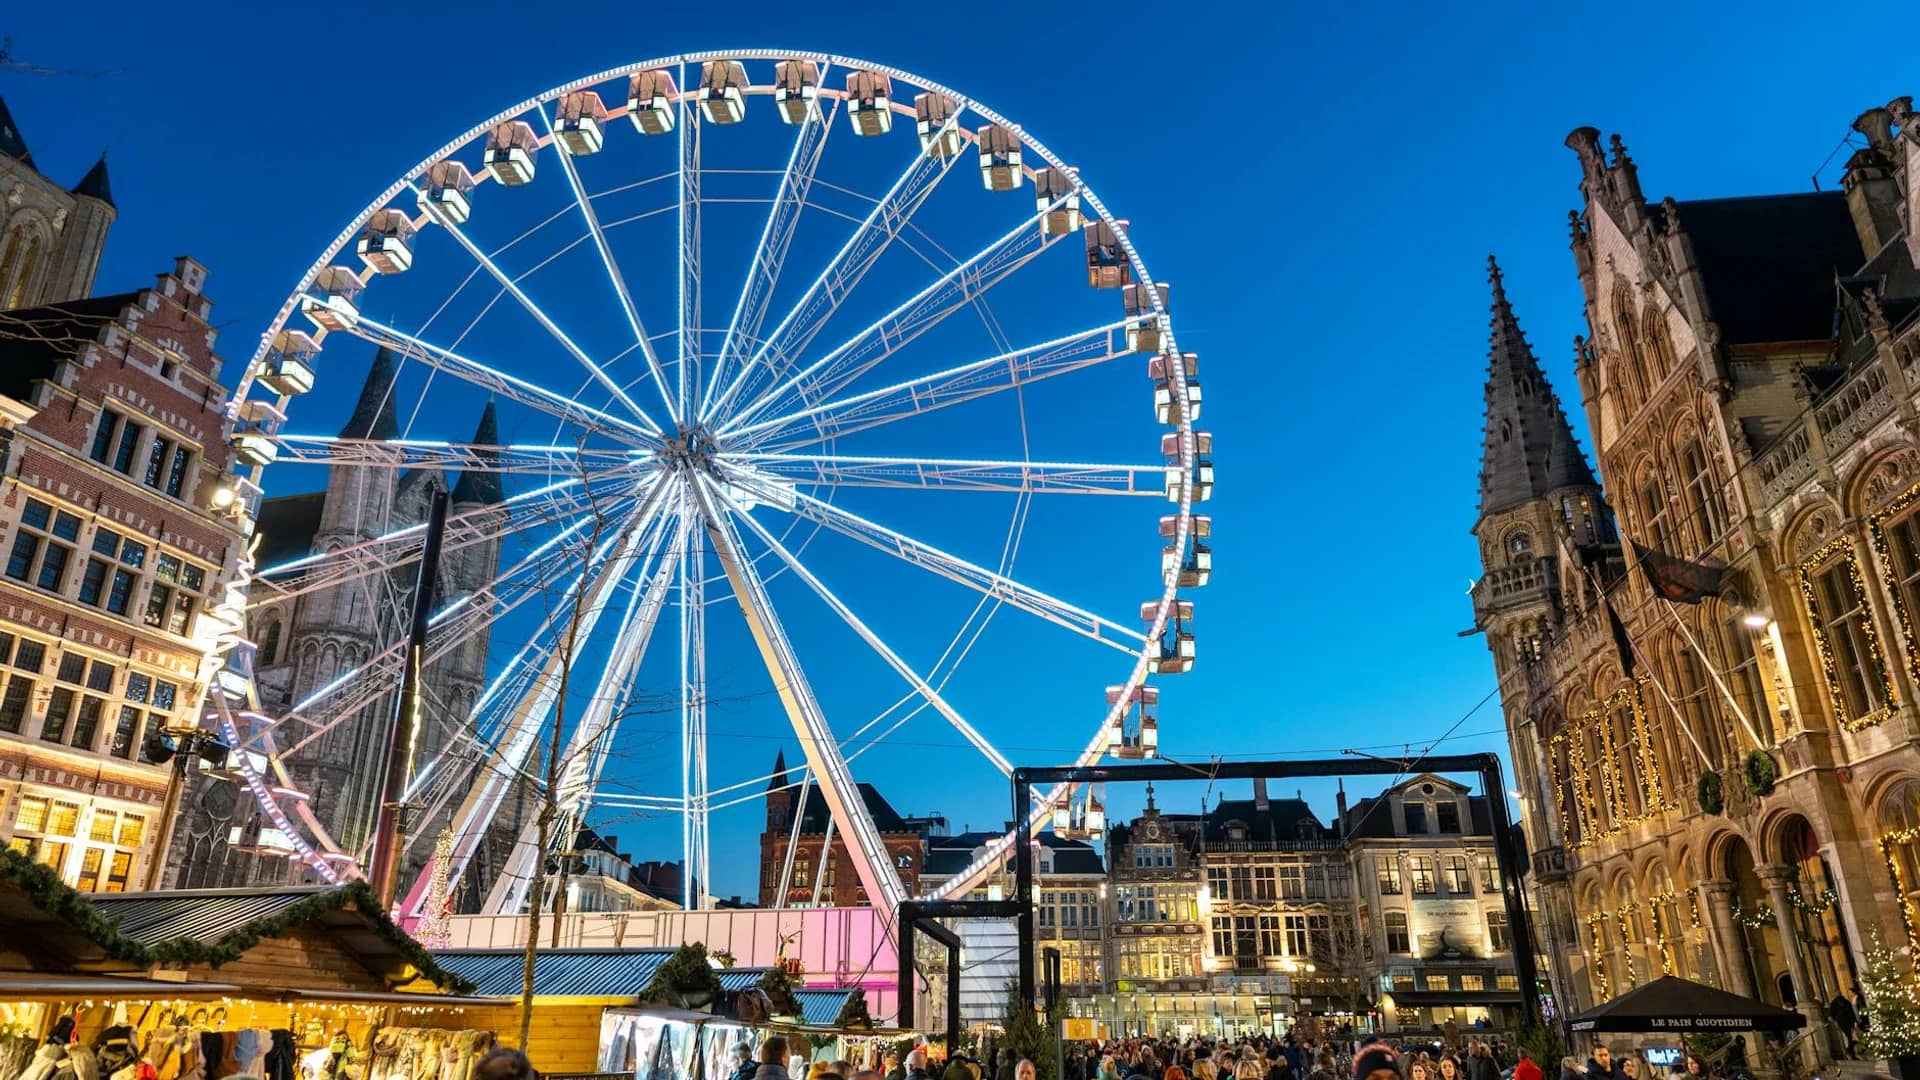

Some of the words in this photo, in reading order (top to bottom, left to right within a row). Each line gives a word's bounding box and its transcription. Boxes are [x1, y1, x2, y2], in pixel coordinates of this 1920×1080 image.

[1651, 1018, 1665, 1027] LE
[1668, 1018, 1692, 1027] PAIN
[1695, 1018, 1753, 1027] QUOTIDIEN
